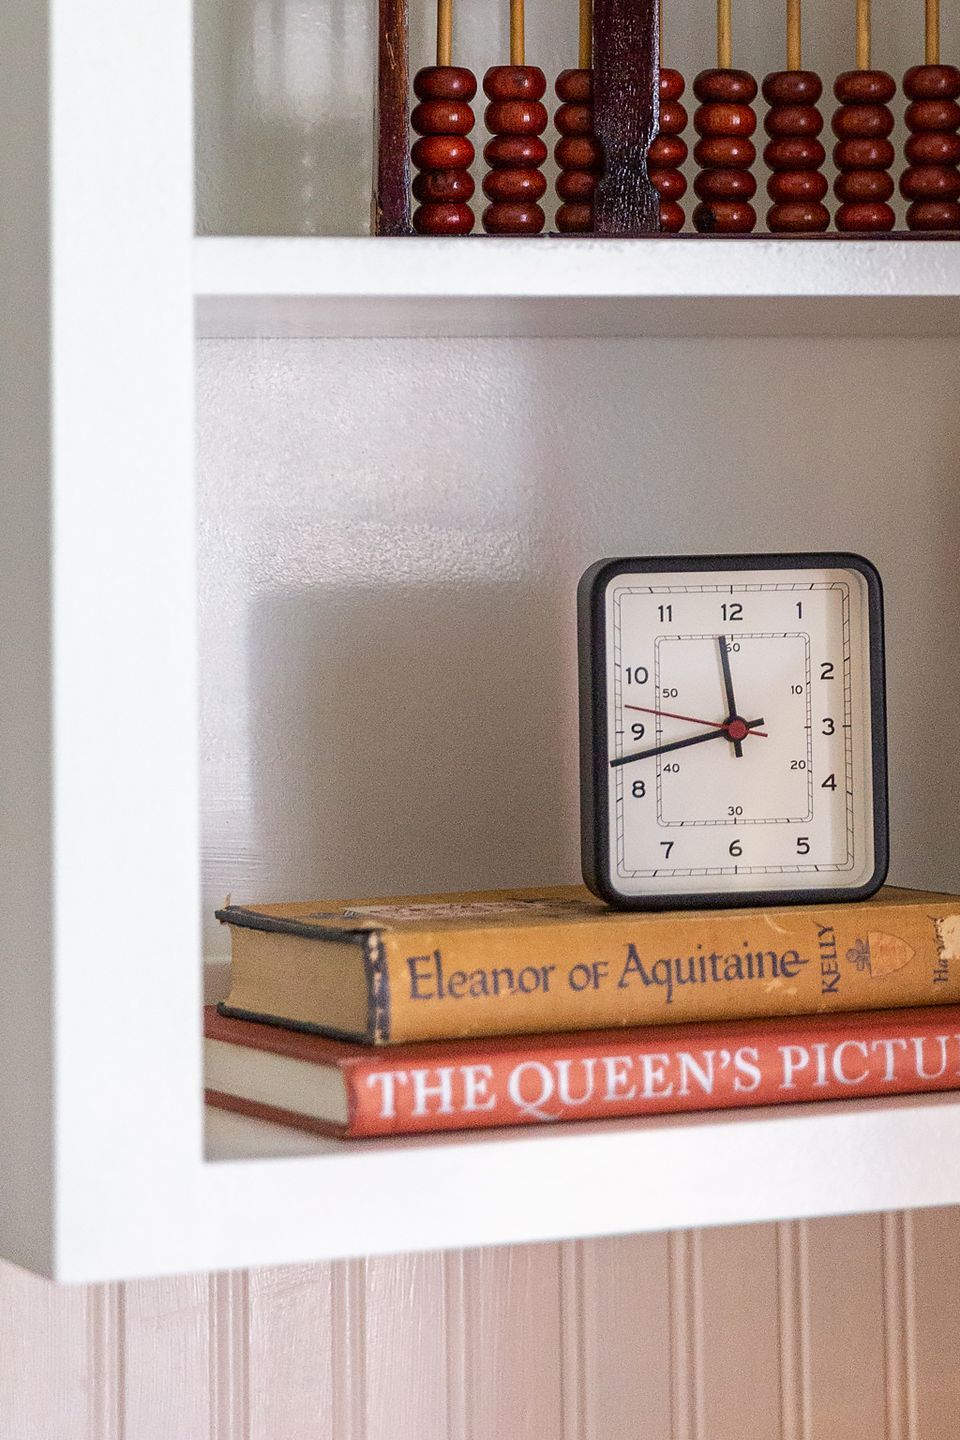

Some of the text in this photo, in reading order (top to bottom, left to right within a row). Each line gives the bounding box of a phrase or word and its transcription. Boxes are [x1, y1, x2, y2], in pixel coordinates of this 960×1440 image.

[658, 605, 673, 622] 11
[720, 603, 743, 621] 12
[796, 602, 803, 619] 1
[625, 667, 649, 685] 10
[820, 663, 834, 680] 2
[662, 688, 678, 698] 50
[791, 685, 803, 695] 10
[631, 723, 645, 740] 9
[822, 718, 835, 735] 3
[663, 763, 680, 773] 40
[790, 760, 806, 770] 20
[632, 781, 646, 798] 8
[821, 774, 837, 791] 4
[728, 806, 743, 816] 30
[660, 842, 674, 859] 7
[729, 840, 743, 857] 6
[797, 838, 810, 855] 5
[813, 920, 841, 994] KELLY
[406, 949, 555, 1000] Eleanor
[617, 941, 810, 1004] Aquitaine
[366, 1063, 496, 1119] THE
[507, 1045, 759, 1121] QUEEN'S
